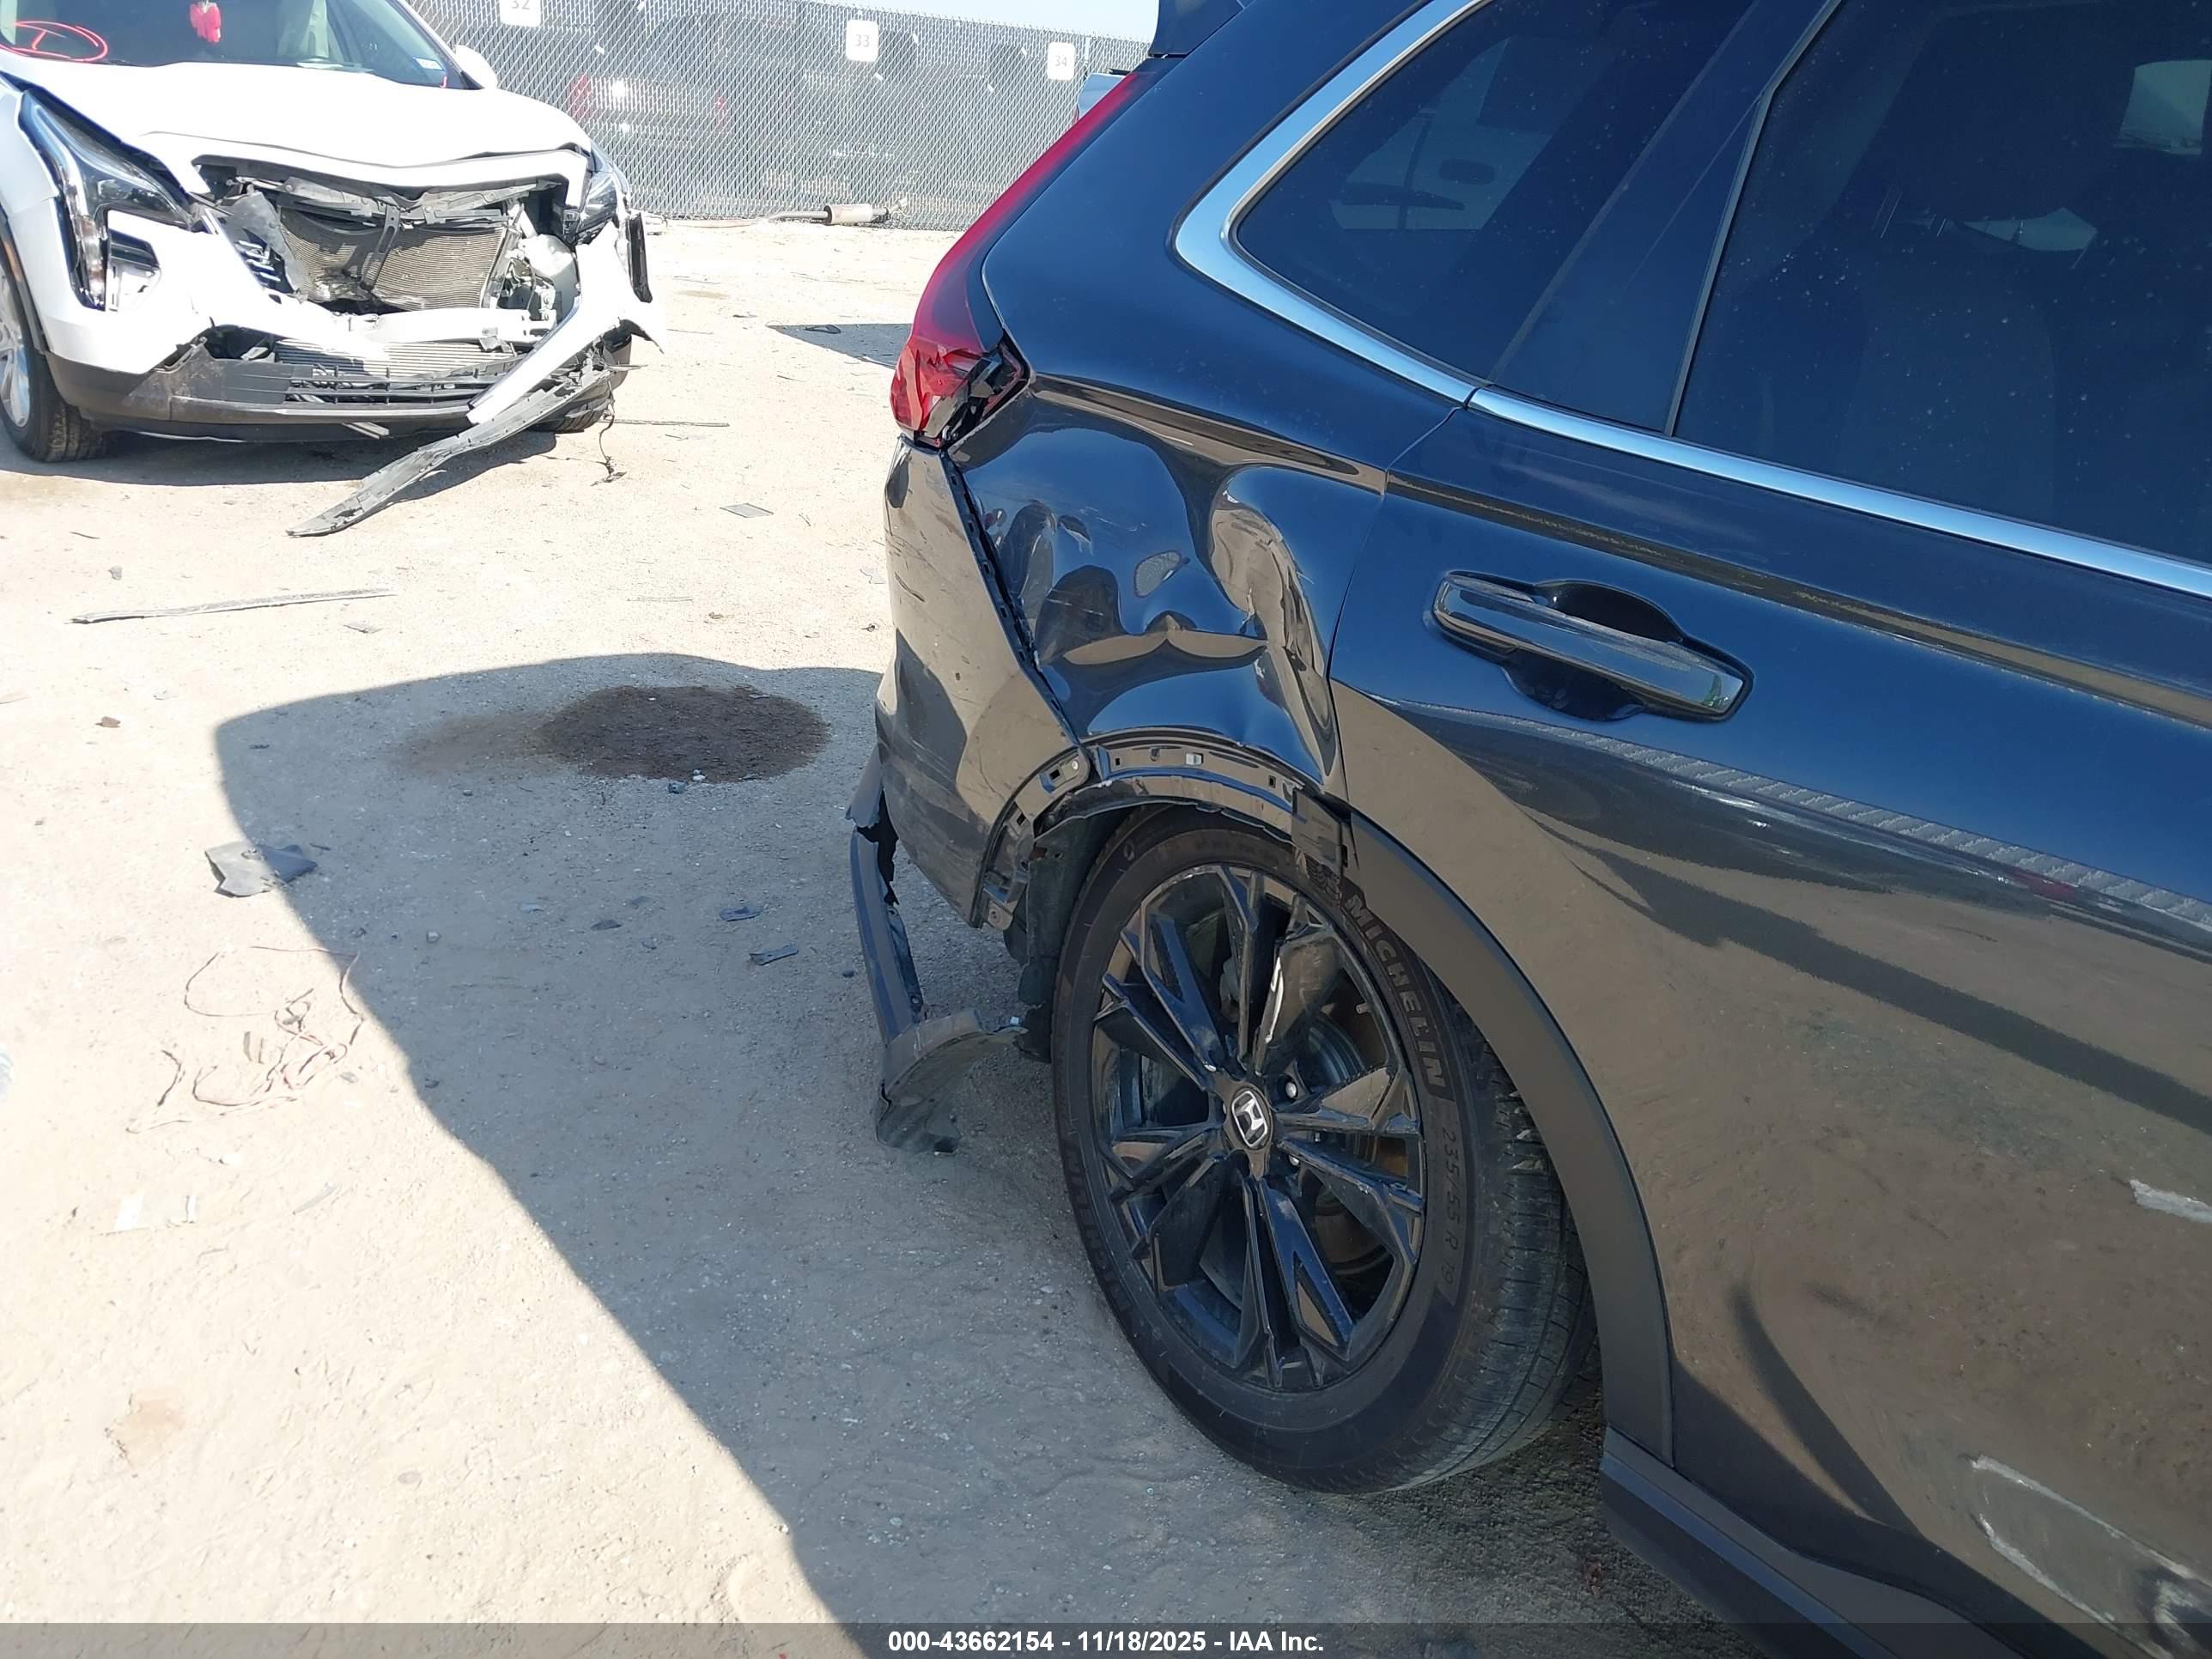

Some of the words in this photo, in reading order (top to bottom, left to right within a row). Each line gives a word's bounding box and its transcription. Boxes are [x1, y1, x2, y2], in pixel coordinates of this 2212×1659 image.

[854, 33, 870, 48] 33
[1054, 55, 1067, 67] 34
[1344, 893, 1447, 1089] MICHELIN
[1442, 1127, 1461, 1224] 235/55
[1443, 1229, 1459, 1251] R
[1441, 1262, 1455, 1285] 19
